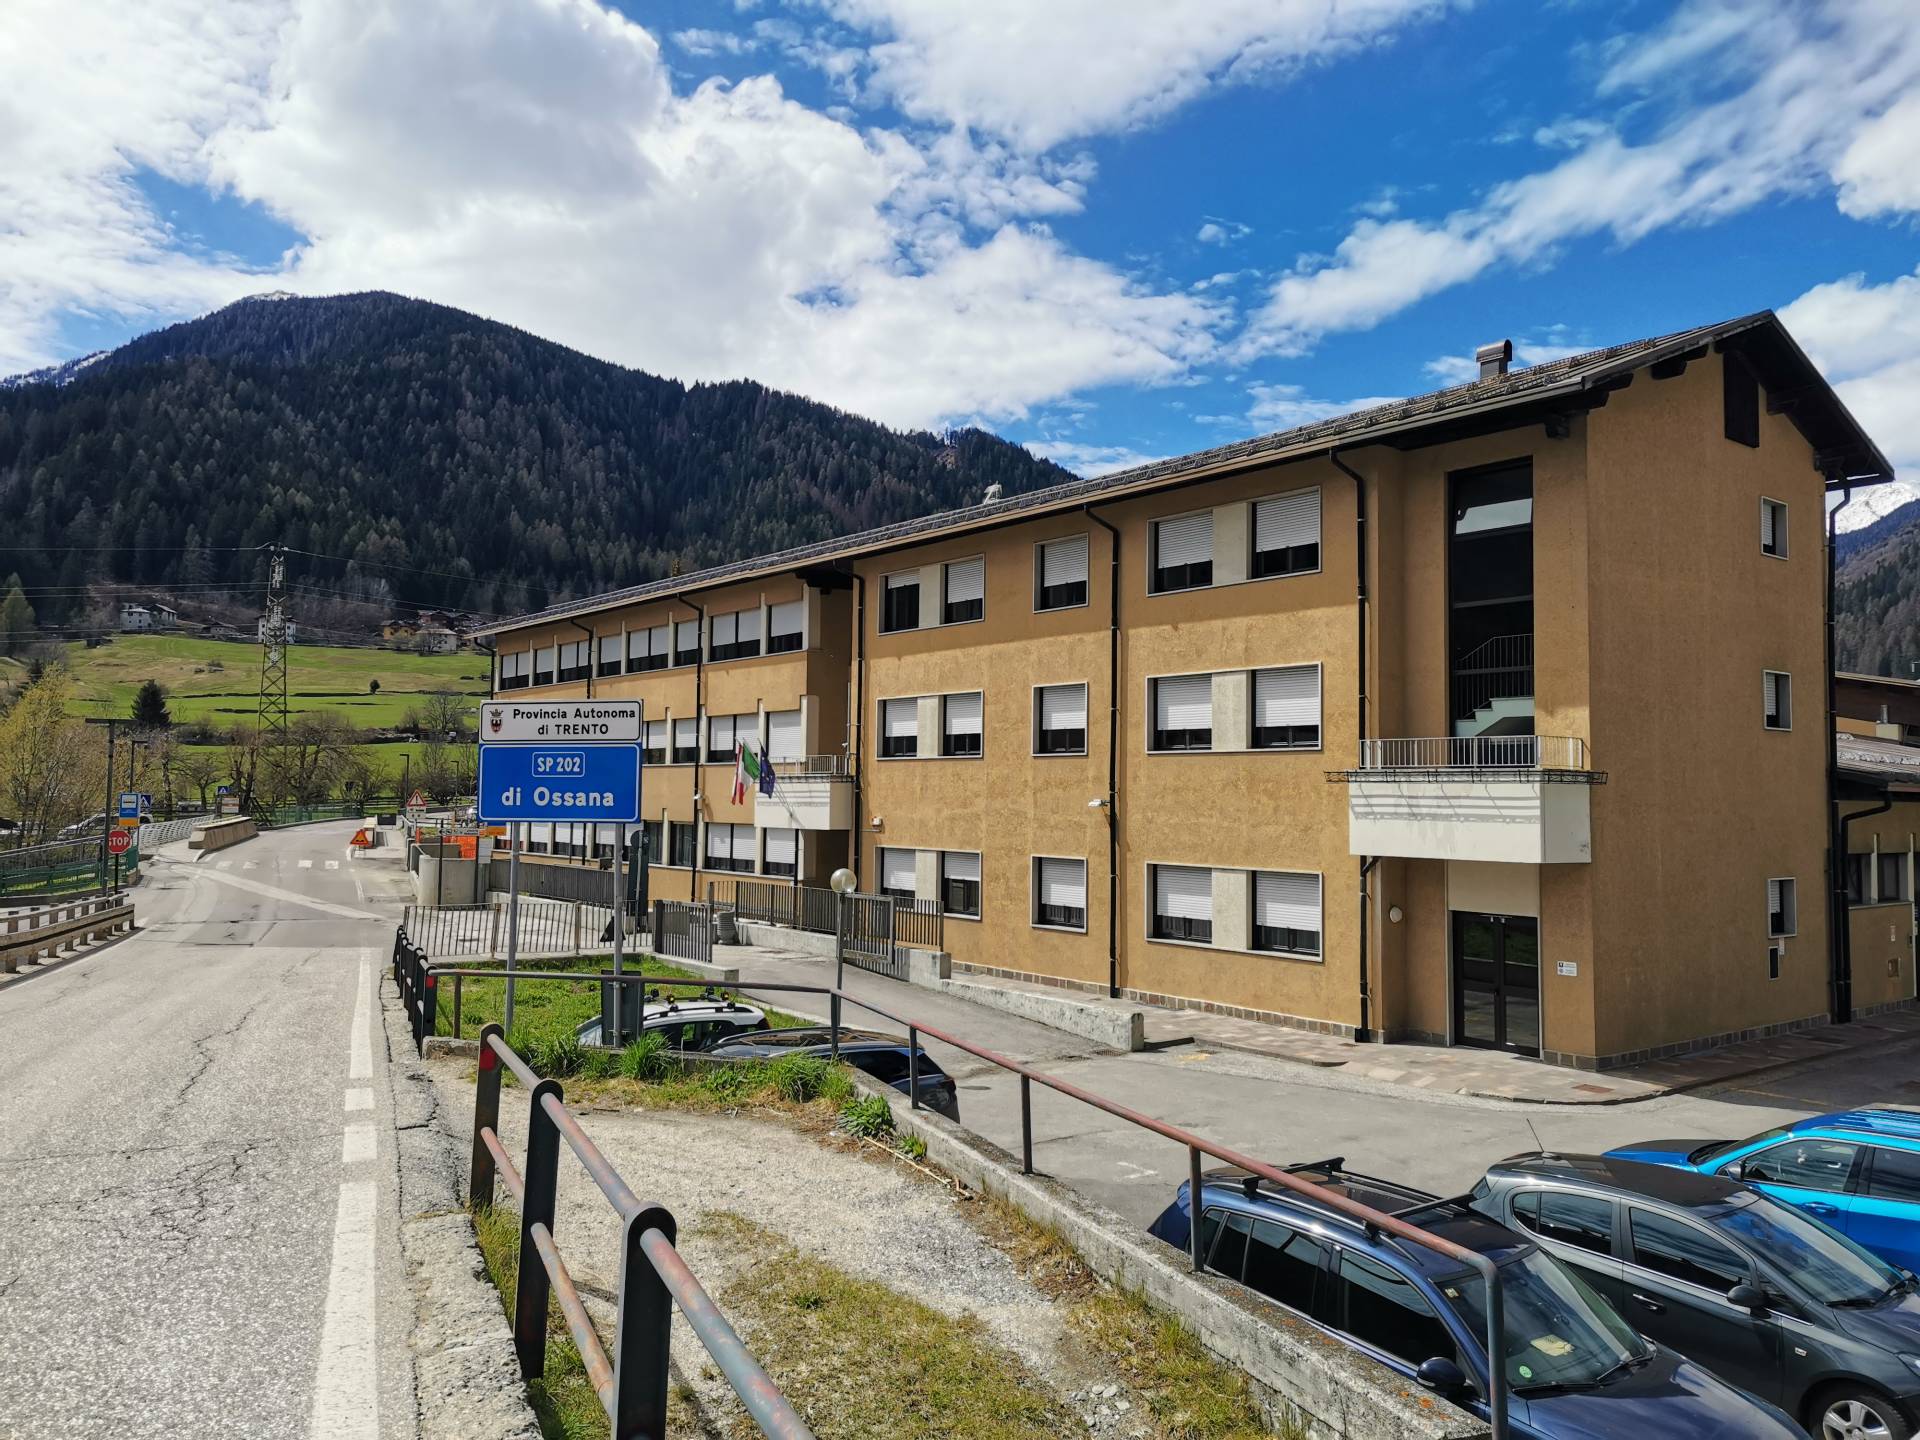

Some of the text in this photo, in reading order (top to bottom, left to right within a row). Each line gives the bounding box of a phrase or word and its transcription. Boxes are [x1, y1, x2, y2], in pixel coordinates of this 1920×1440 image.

[513, 707, 636, 719] Provincia Autonoma
[537, 723, 609, 735] di TRENTO
[537, 757, 581, 772] SP 202
[501, 786, 615, 807] di Ossana
